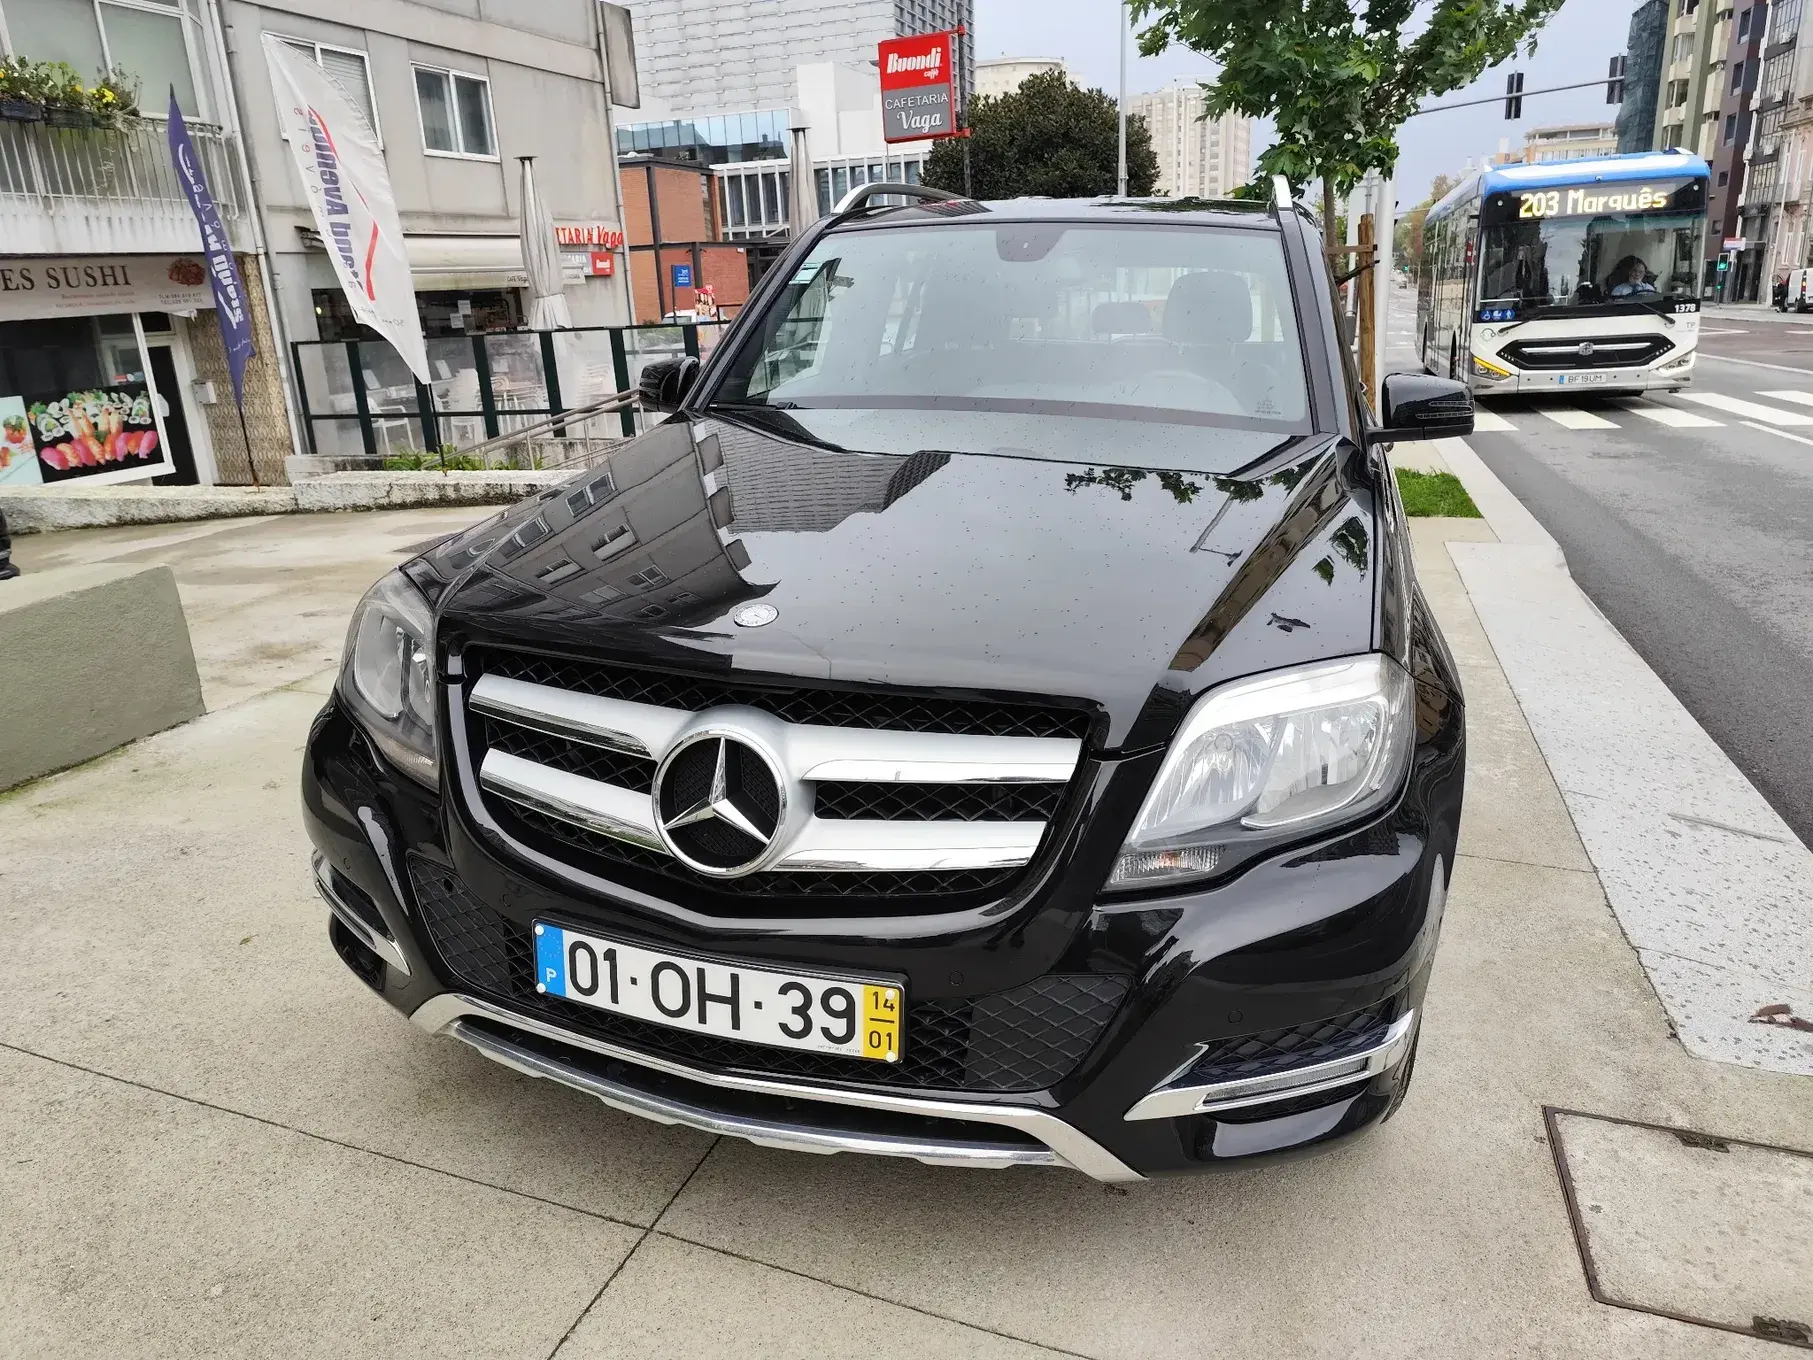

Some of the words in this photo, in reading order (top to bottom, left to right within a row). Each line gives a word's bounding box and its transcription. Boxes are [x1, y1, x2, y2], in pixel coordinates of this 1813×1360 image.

[887, 47, 942, 74] Buondi
[885, 92, 949, 110] CAFETARIA
[896, 110, 943, 133] Vaga
[1519, 190, 1560, 219] 203
[1566, 187, 1669, 215] Marquês
[0, 267, 35, 291] ES
[46, 265, 132, 290] SUSHI
[546, 967, 557, 982] P
[872, 990, 895, 1012] 14
[868, 1030, 894, 1051] 01
